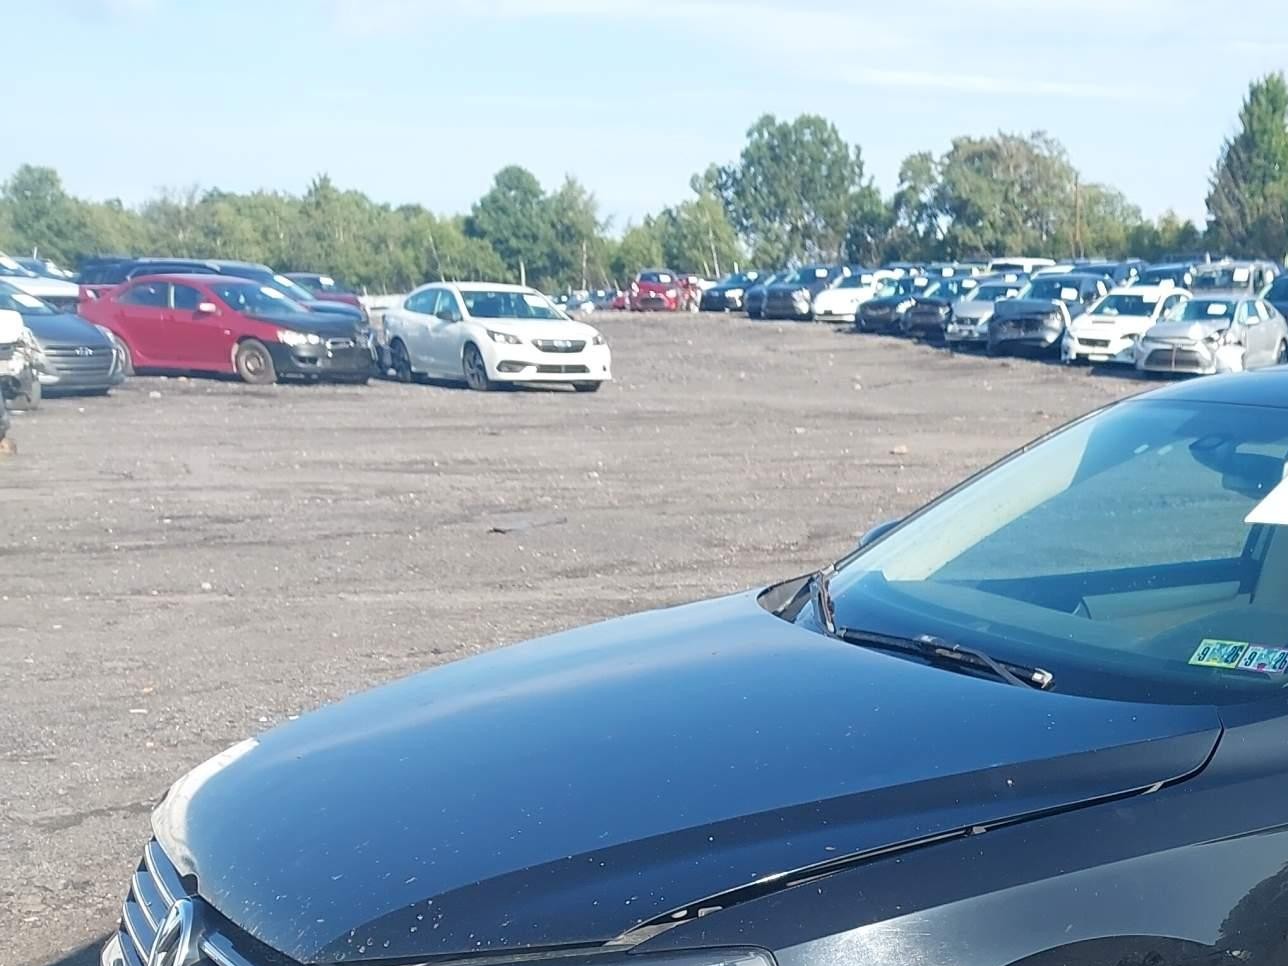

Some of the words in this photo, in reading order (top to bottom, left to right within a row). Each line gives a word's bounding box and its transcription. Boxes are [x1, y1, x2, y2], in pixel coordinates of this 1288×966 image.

[1197, 646, 1211, 662] 9
[1224, 645, 1245, 665] 26
[1244, 651, 1258, 667] 9
